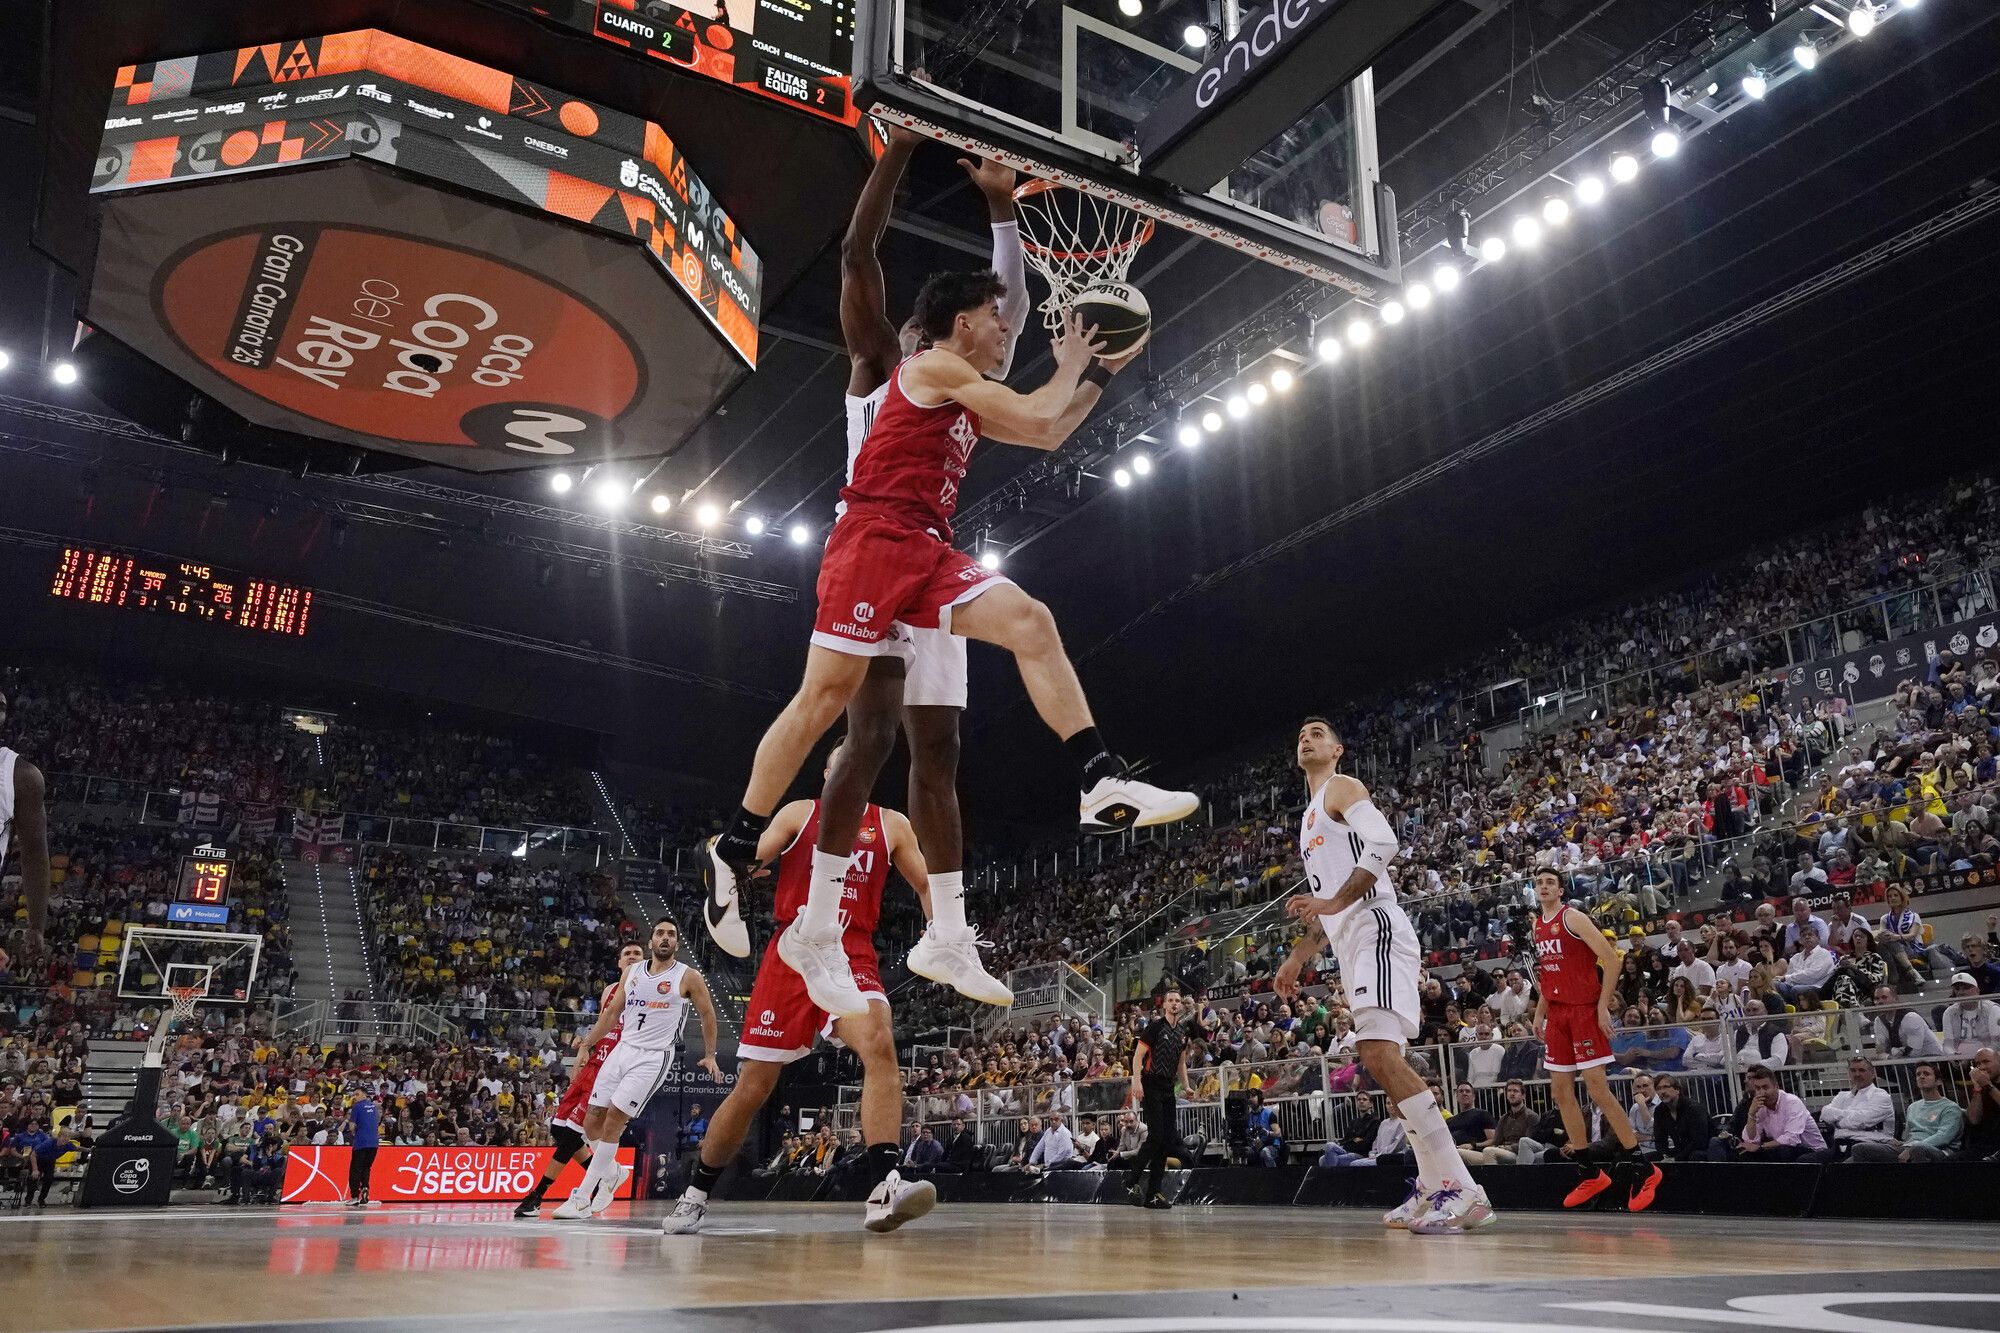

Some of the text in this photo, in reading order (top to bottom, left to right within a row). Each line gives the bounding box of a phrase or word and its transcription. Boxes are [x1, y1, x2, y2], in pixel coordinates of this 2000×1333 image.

[604, 12, 672, 48] CUARTO 2
[752, 40, 842, 77] COACH DIEGO OCAMPO
[768, 67, 808, 90] FALTAS
[258, 92, 287, 103] renfe
[295, 92, 333, 103] EXPRESS
[765, 77, 825, 104] EQUIPO 2
[105, 117, 143, 129] Wilson
[524, 137, 568, 156] ONEBOX
[262, 234, 303, 283] Gran
[711, 255, 749, 310] endesa
[240, 283, 289, 346] Canaria
[276, 278, 405, 389] del Rey
[382, 294, 499, 398] Copa
[471, 334, 533, 387] acb
[180, 564, 210, 579] 4:45
[144, 578, 161, 590] 39
[183, 586, 190, 595] 2
[140, 596, 146, 605] 3
[215, 591, 231, 604] 26
[225, 611, 232, 619] 2
[832, 622, 878, 639] unilabor
[193, 849, 226, 858] LOTUS
[196, 863, 226, 877] 4:45
[196, 878, 220, 900] 13
[638, 1013, 646, 1030] 7
[750, 1026, 784, 1037] unilabor
[426, 1152, 535, 1170] ALQUILER
[422, 1171, 534, 1194] SEGURO
